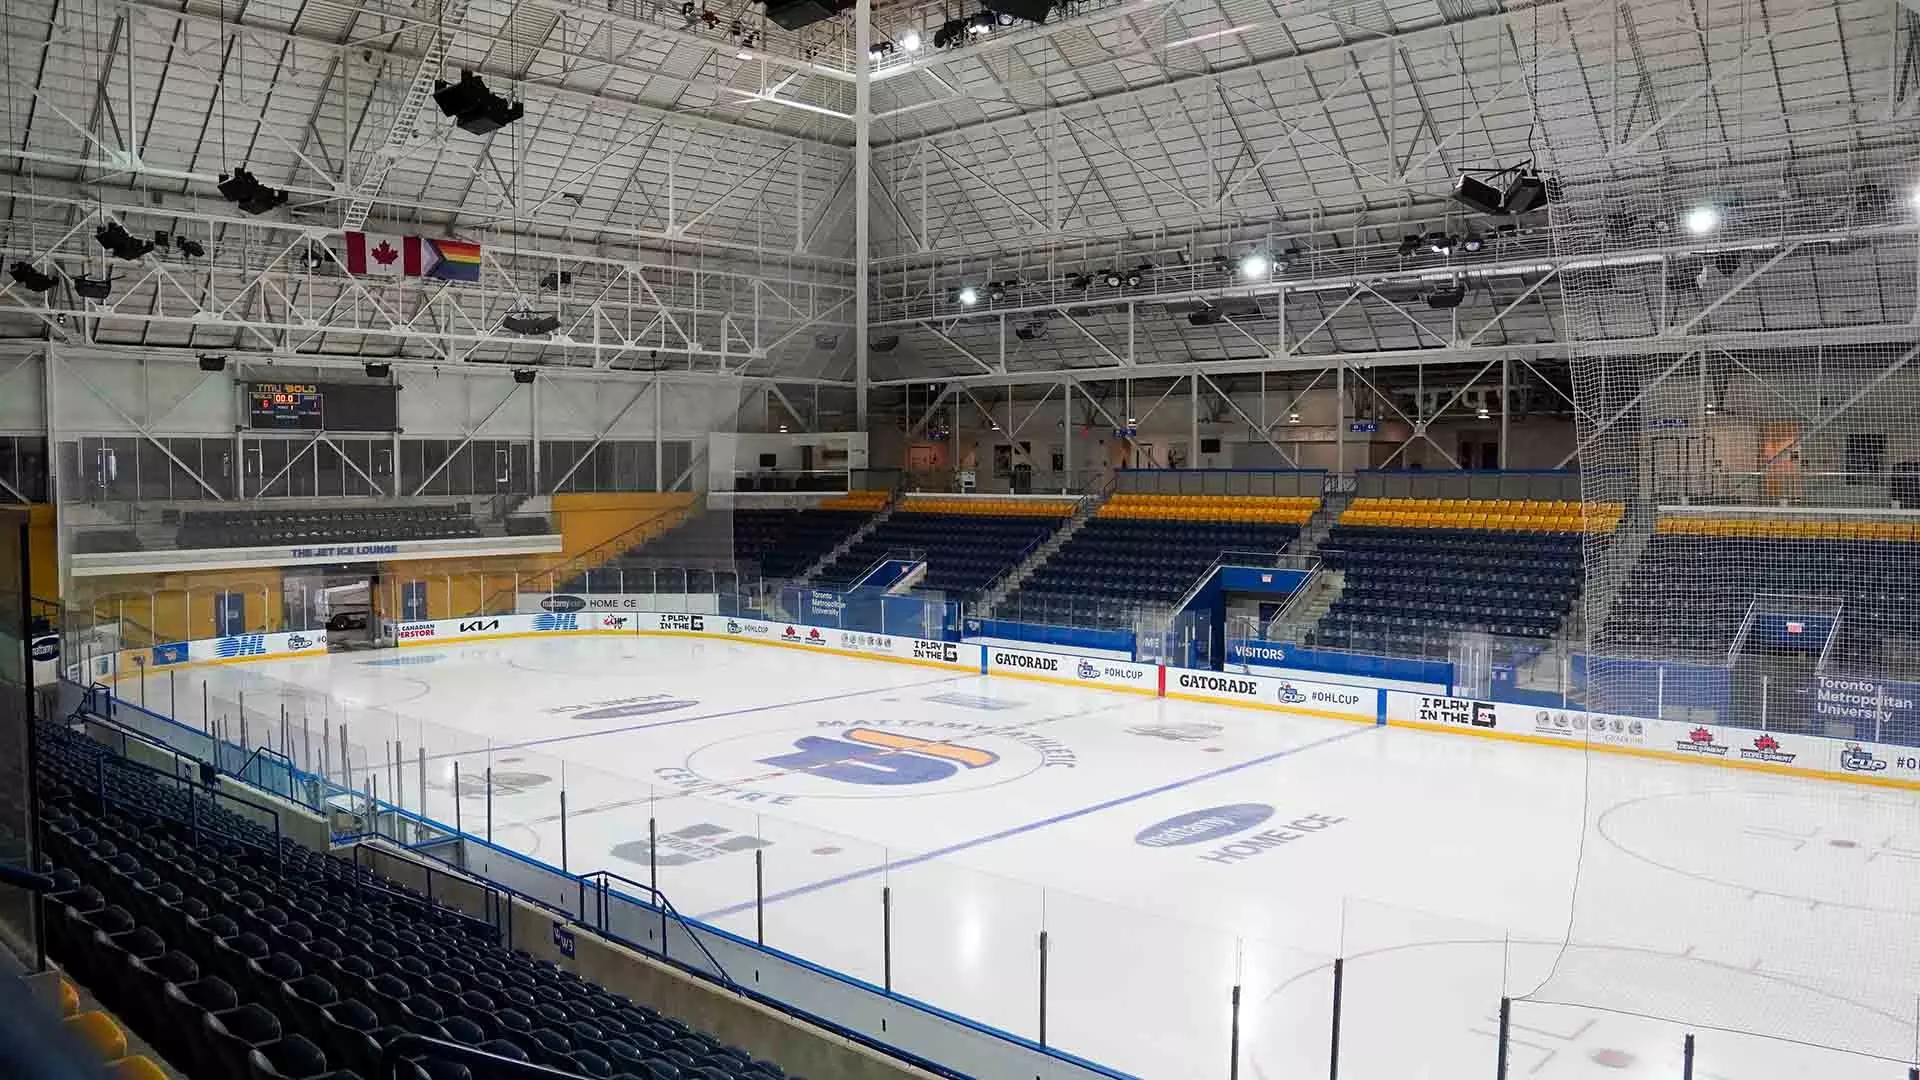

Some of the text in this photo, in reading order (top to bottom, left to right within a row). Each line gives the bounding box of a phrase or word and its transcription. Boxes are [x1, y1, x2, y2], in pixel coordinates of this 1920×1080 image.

[291, 545, 398, 558] THE JET ICE LOUNGE
[460, 620, 499, 632] KIA
[914, 640, 942, 650] I PLAY
[914, 649, 924, 658] IN
[925, 650, 942, 660] THE
[1235, 645, 1285, 661] VISITORS
[995, 653, 1058, 671] GATORADE
[1104, 668, 1143, 679] #OHLCUP
[1179, 674, 1257, 695] GATORADE
[1817, 677, 1874, 693] Toronto
[1312, 691, 1359, 704] #OHLCUP
[1422, 698, 1469, 711] I PLAY
[1817, 690, 1913, 710] Metropolitan
[1420, 702, 1496, 728] IN THE G
[1817, 703, 1892, 722] University
[1848, 758, 1887, 771] CUP
[1198, 813, 1346, 864] HOME ICE
